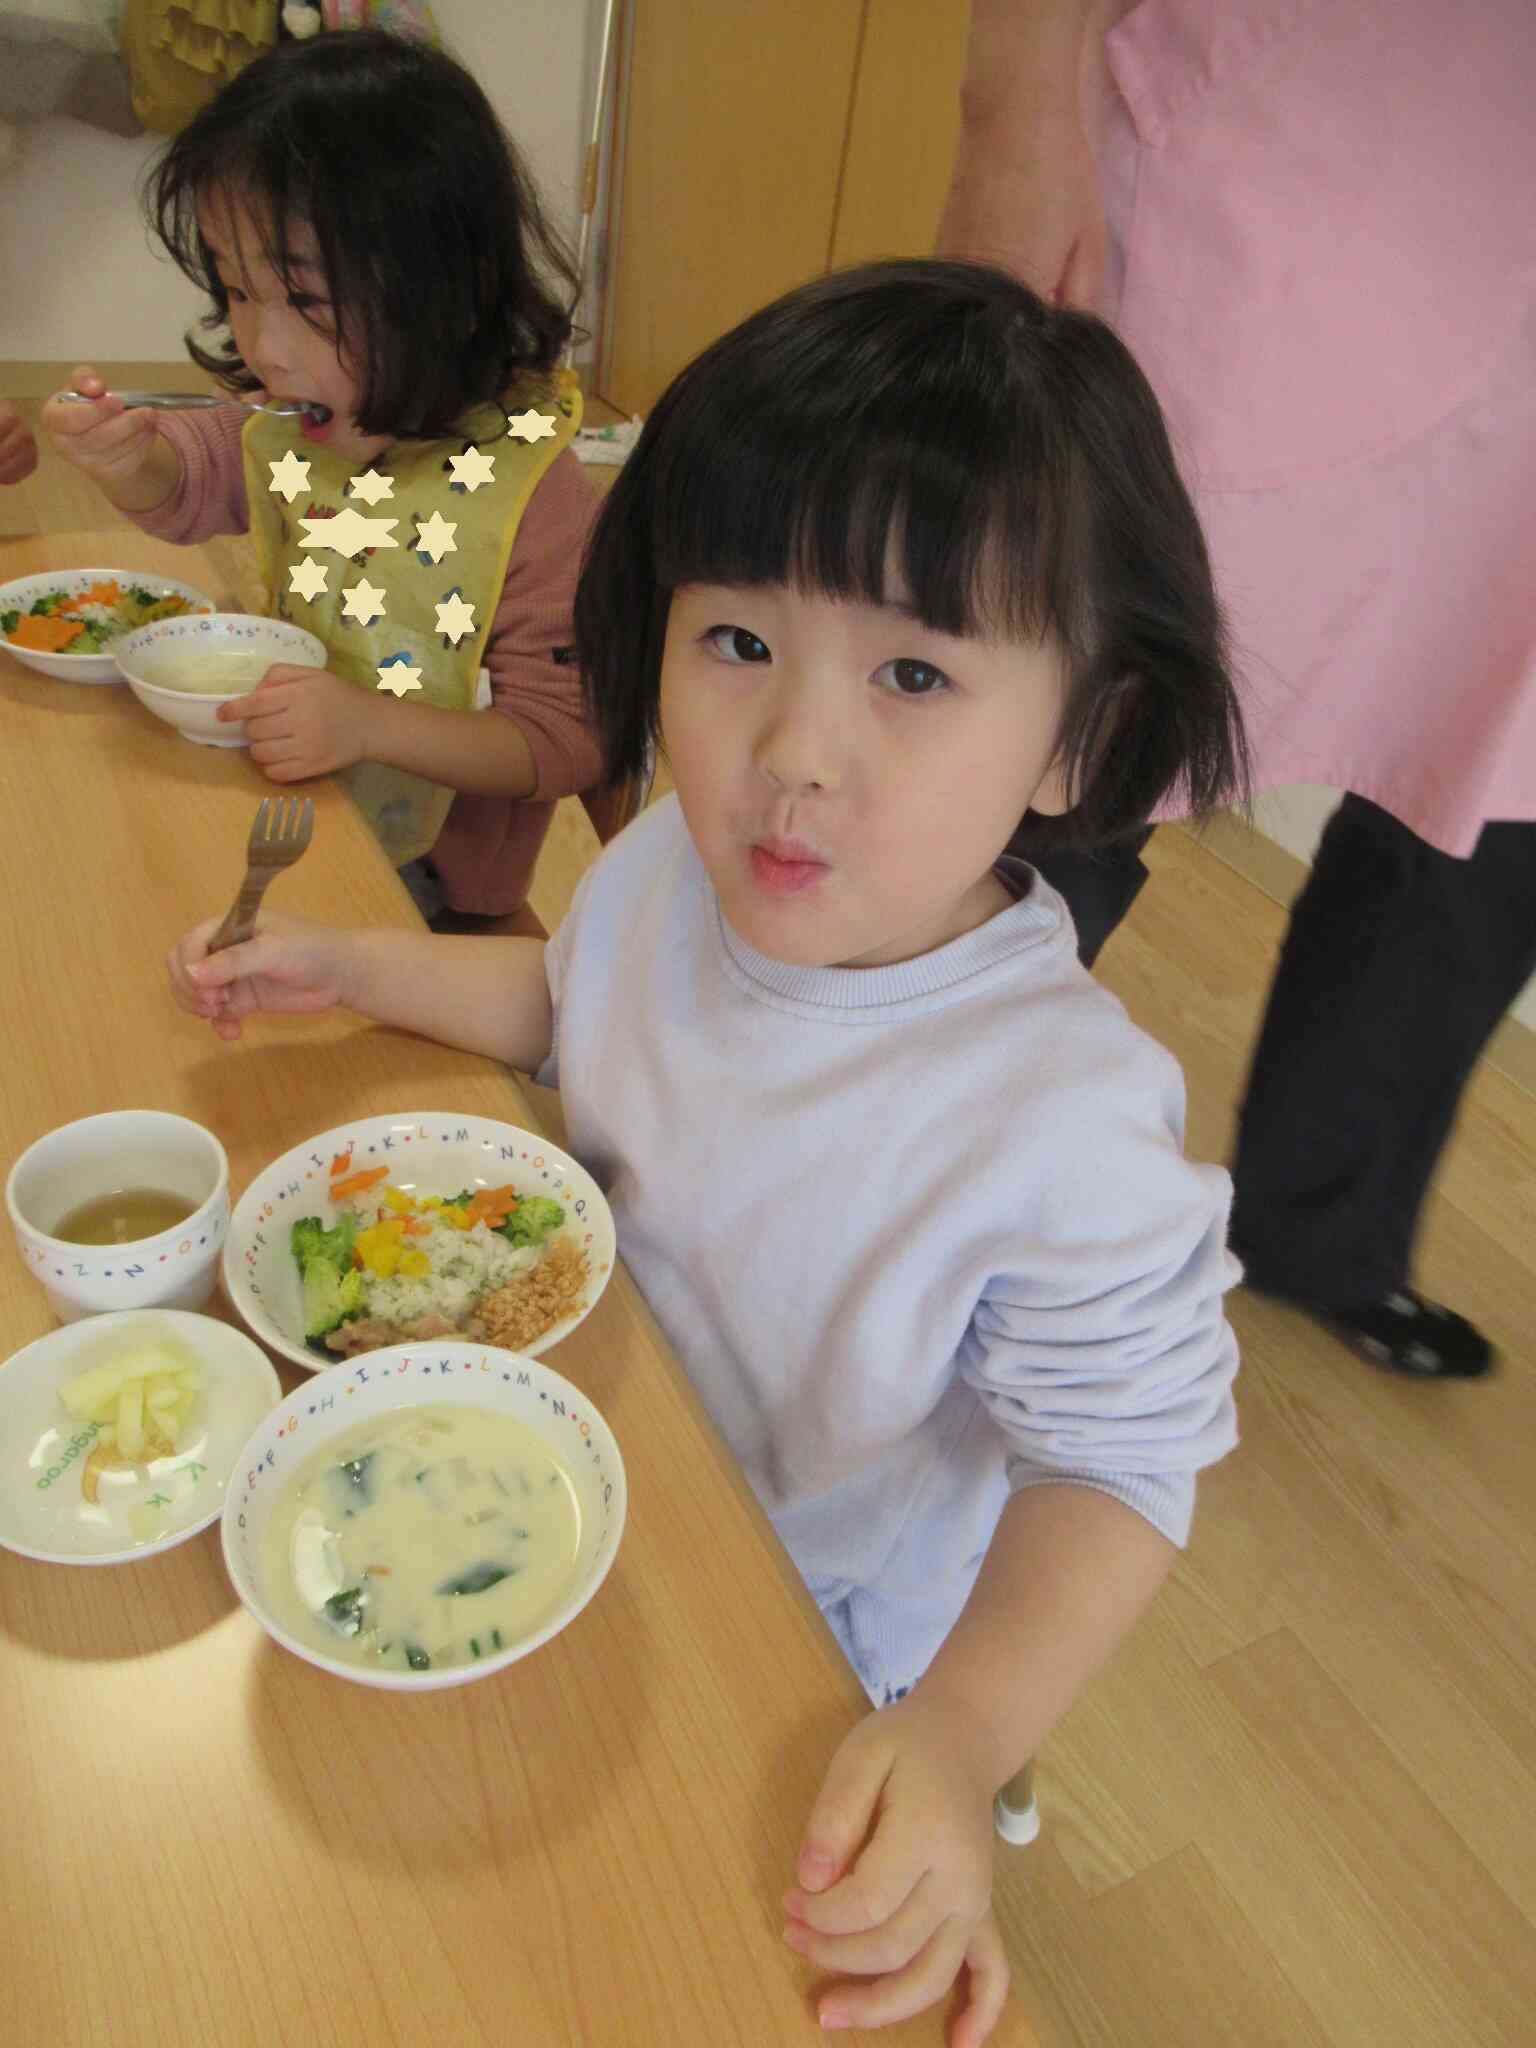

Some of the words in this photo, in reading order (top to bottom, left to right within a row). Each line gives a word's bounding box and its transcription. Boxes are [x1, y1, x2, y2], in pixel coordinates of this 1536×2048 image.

[310, 1153, 323, 1167] I
[382, 1136, 395, 1150] K
[418, 1126, 429, 1139] L
[455, 1128, 469, 1141] M
[500, 1146, 514, 1159] N
[534, 1155, 545, 1168] O
[575, 1199, 586, 1216] Q
[72, 1263, 89, 1277] Z
[124, 1263, 146, 1279] N
[178, 1239, 192, 1254] O
[287, 1415, 297, 1431] G
[320, 1395, 334, 1410] H
[356, 1368, 370, 1382] I
[398, 1359, 411, 1373] J
[439, 1359, 452, 1373] K
[479, 1356, 490, 1370] L
[516, 1373, 530, 1386] M
[552, 1399, 565, 1416] N
[579, 1421, 589, 1437] O
[36, 1422, 105, 1489] ngaroo
